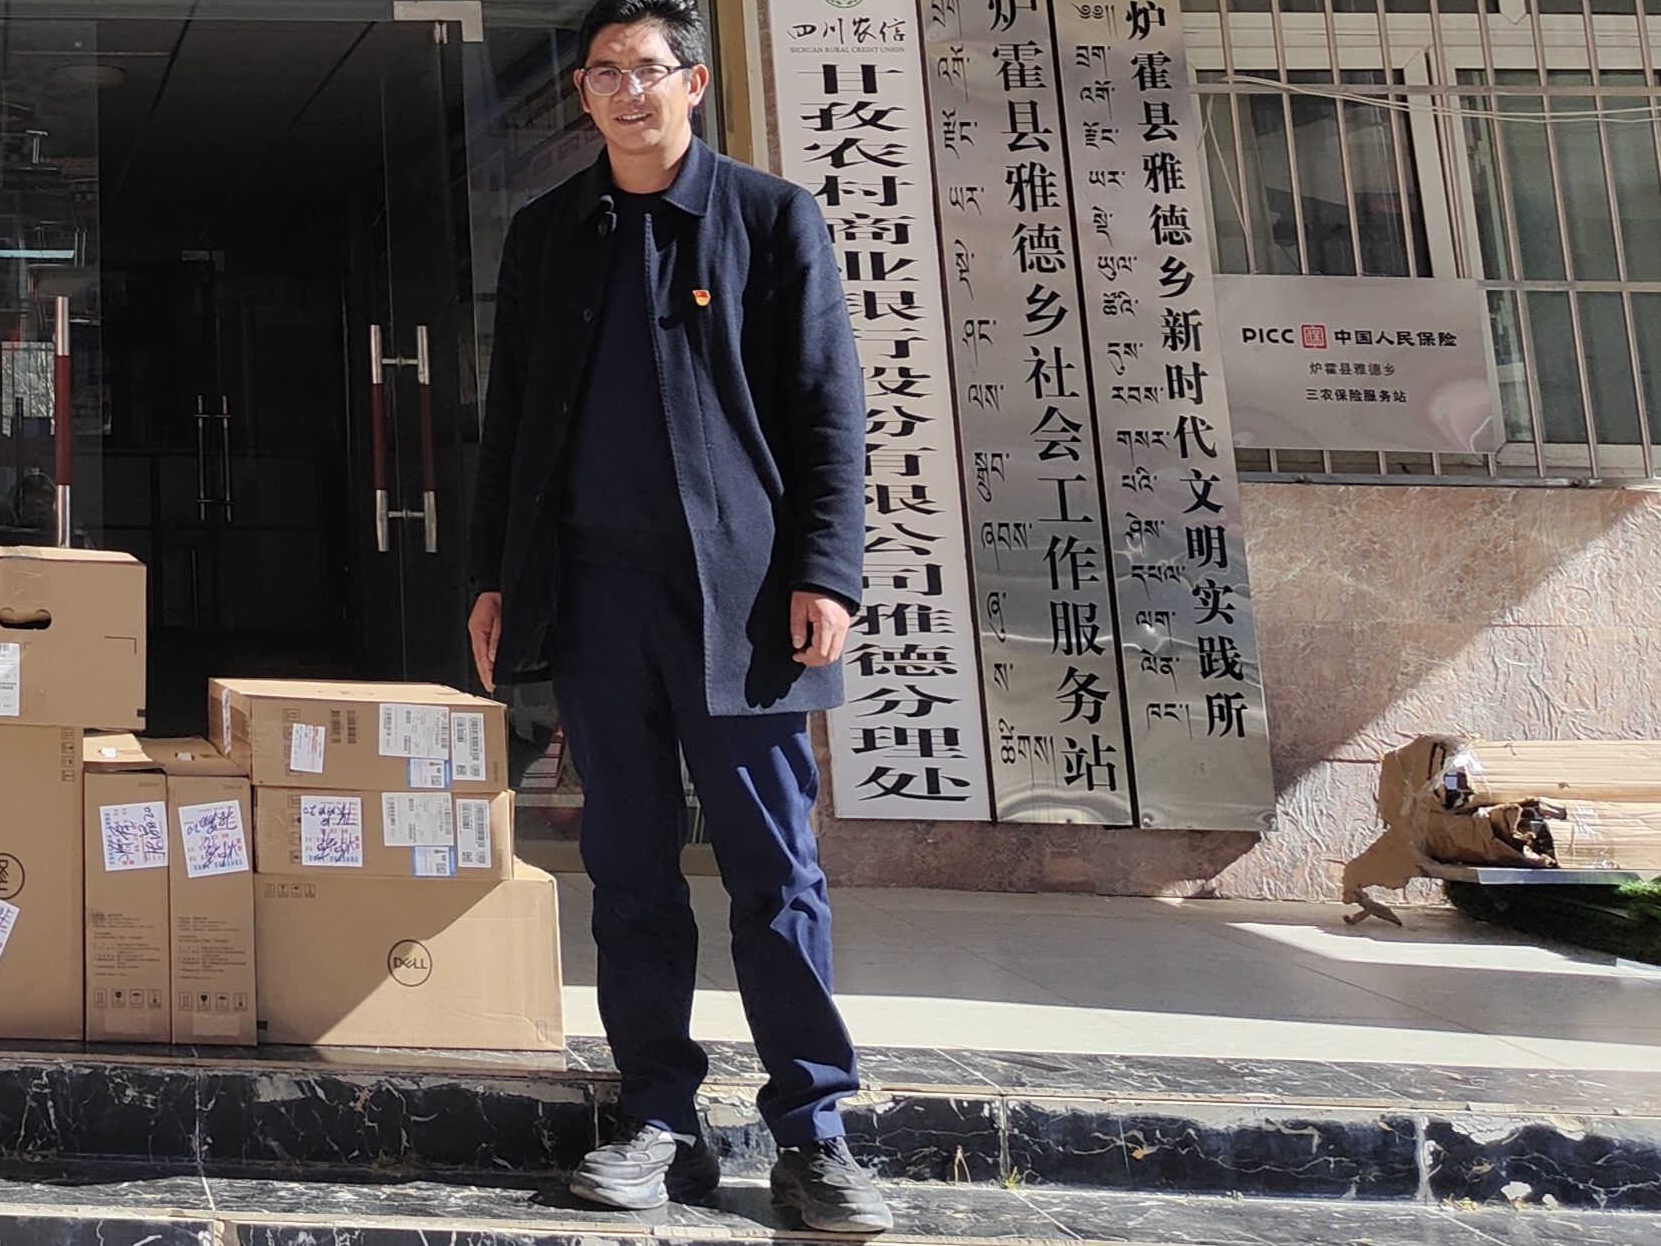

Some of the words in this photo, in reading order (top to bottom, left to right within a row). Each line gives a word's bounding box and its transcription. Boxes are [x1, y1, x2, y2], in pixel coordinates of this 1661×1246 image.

[787, 17, 906, 45] 四川农信
[880, 45, 905, 53] UNION
[1241, 327, 1295, 345] PICC
[1334, 328, 1458, 348] 中国人民保险
[1125, 0, 1249, 739] 炉霍县雅德乡新时代文明实践所
[1309, 361, 1396, 377] 炉霍县雅德乡
[1306, 388, 1407, 404] 三农保险服务站
[797, 63, 973, 804] 甘孜农村商业银行股份有限公司雅德分理处
[394, 957, 426, 969] DELL
